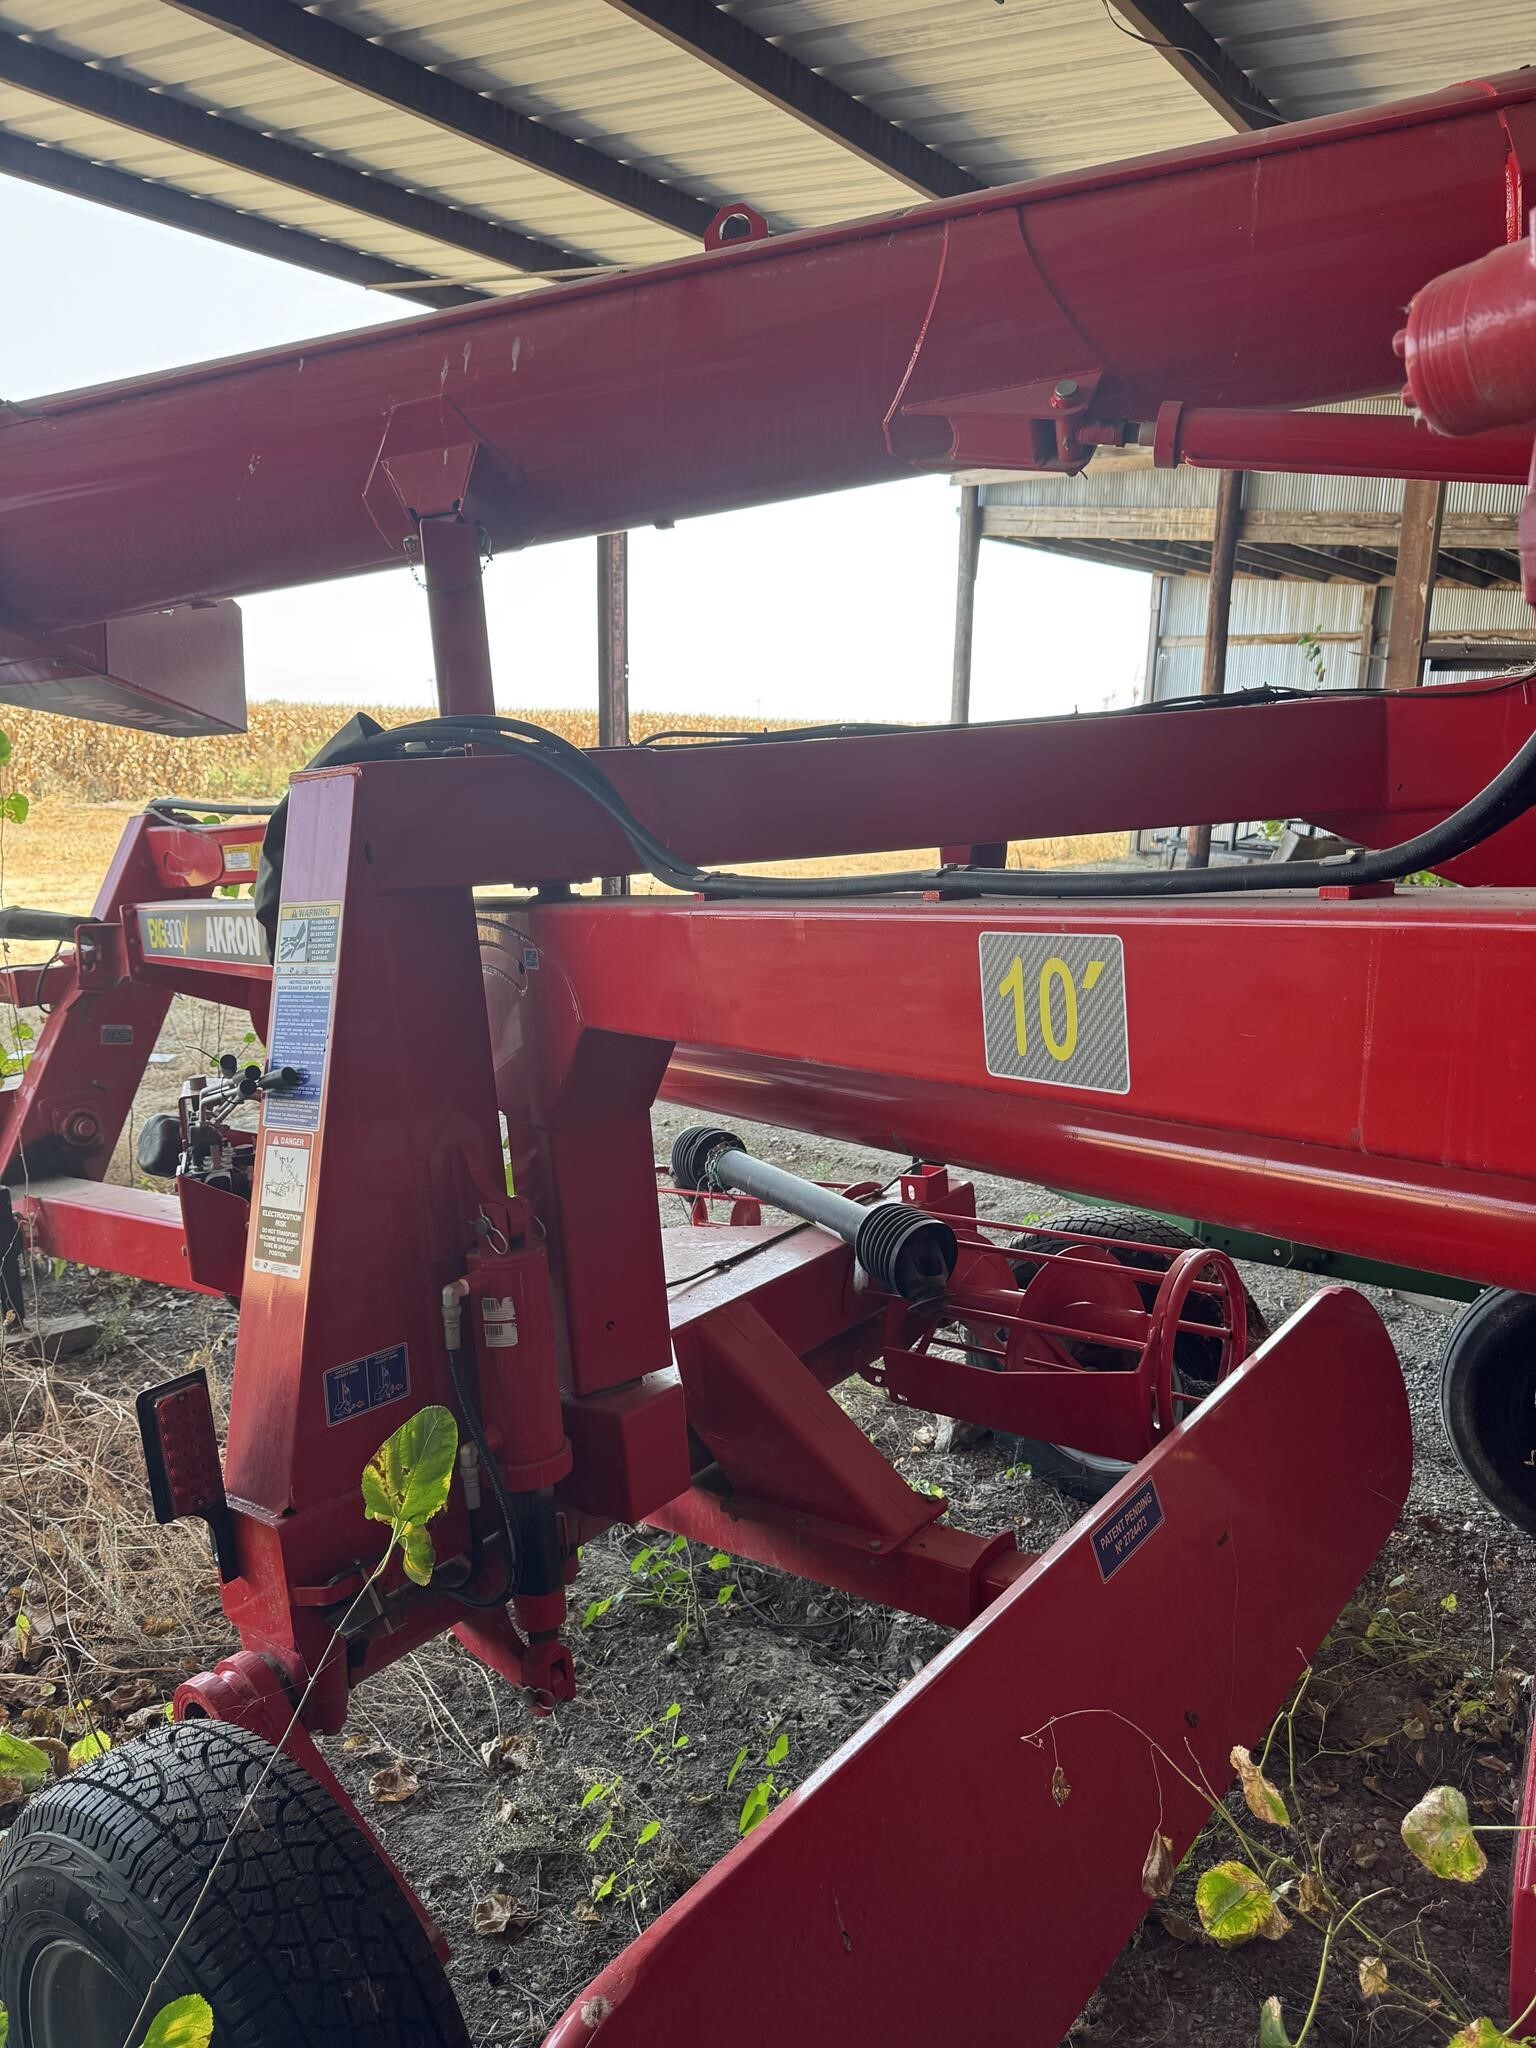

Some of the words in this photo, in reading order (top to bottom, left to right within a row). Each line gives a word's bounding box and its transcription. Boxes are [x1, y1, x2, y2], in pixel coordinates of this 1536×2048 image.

[298, 907, 330, 917] WARNING
[205, 916, 262, 956] AKRON
[281, 1136, 304, 1146] DANGER
[262, 1209, 302, 1222] ELECTROCUTION
[274, 1219, 288, 1228] RISK
[276, 1229, 299, 1238] TRANSPORT
[259, 1234, 276, 1242] MACHINE
[286, 1238, 300, 1246] AUGER
[263, 1241, 274, 1249] TUBE
[278, 1244, 295, 1252] UPRIGHT
[1099, 1518, 1125, 1551] PATENT
[1124, 1491, 1153, 1526] PENDING
[1122, 1515, 1148, 1547] 2724473
